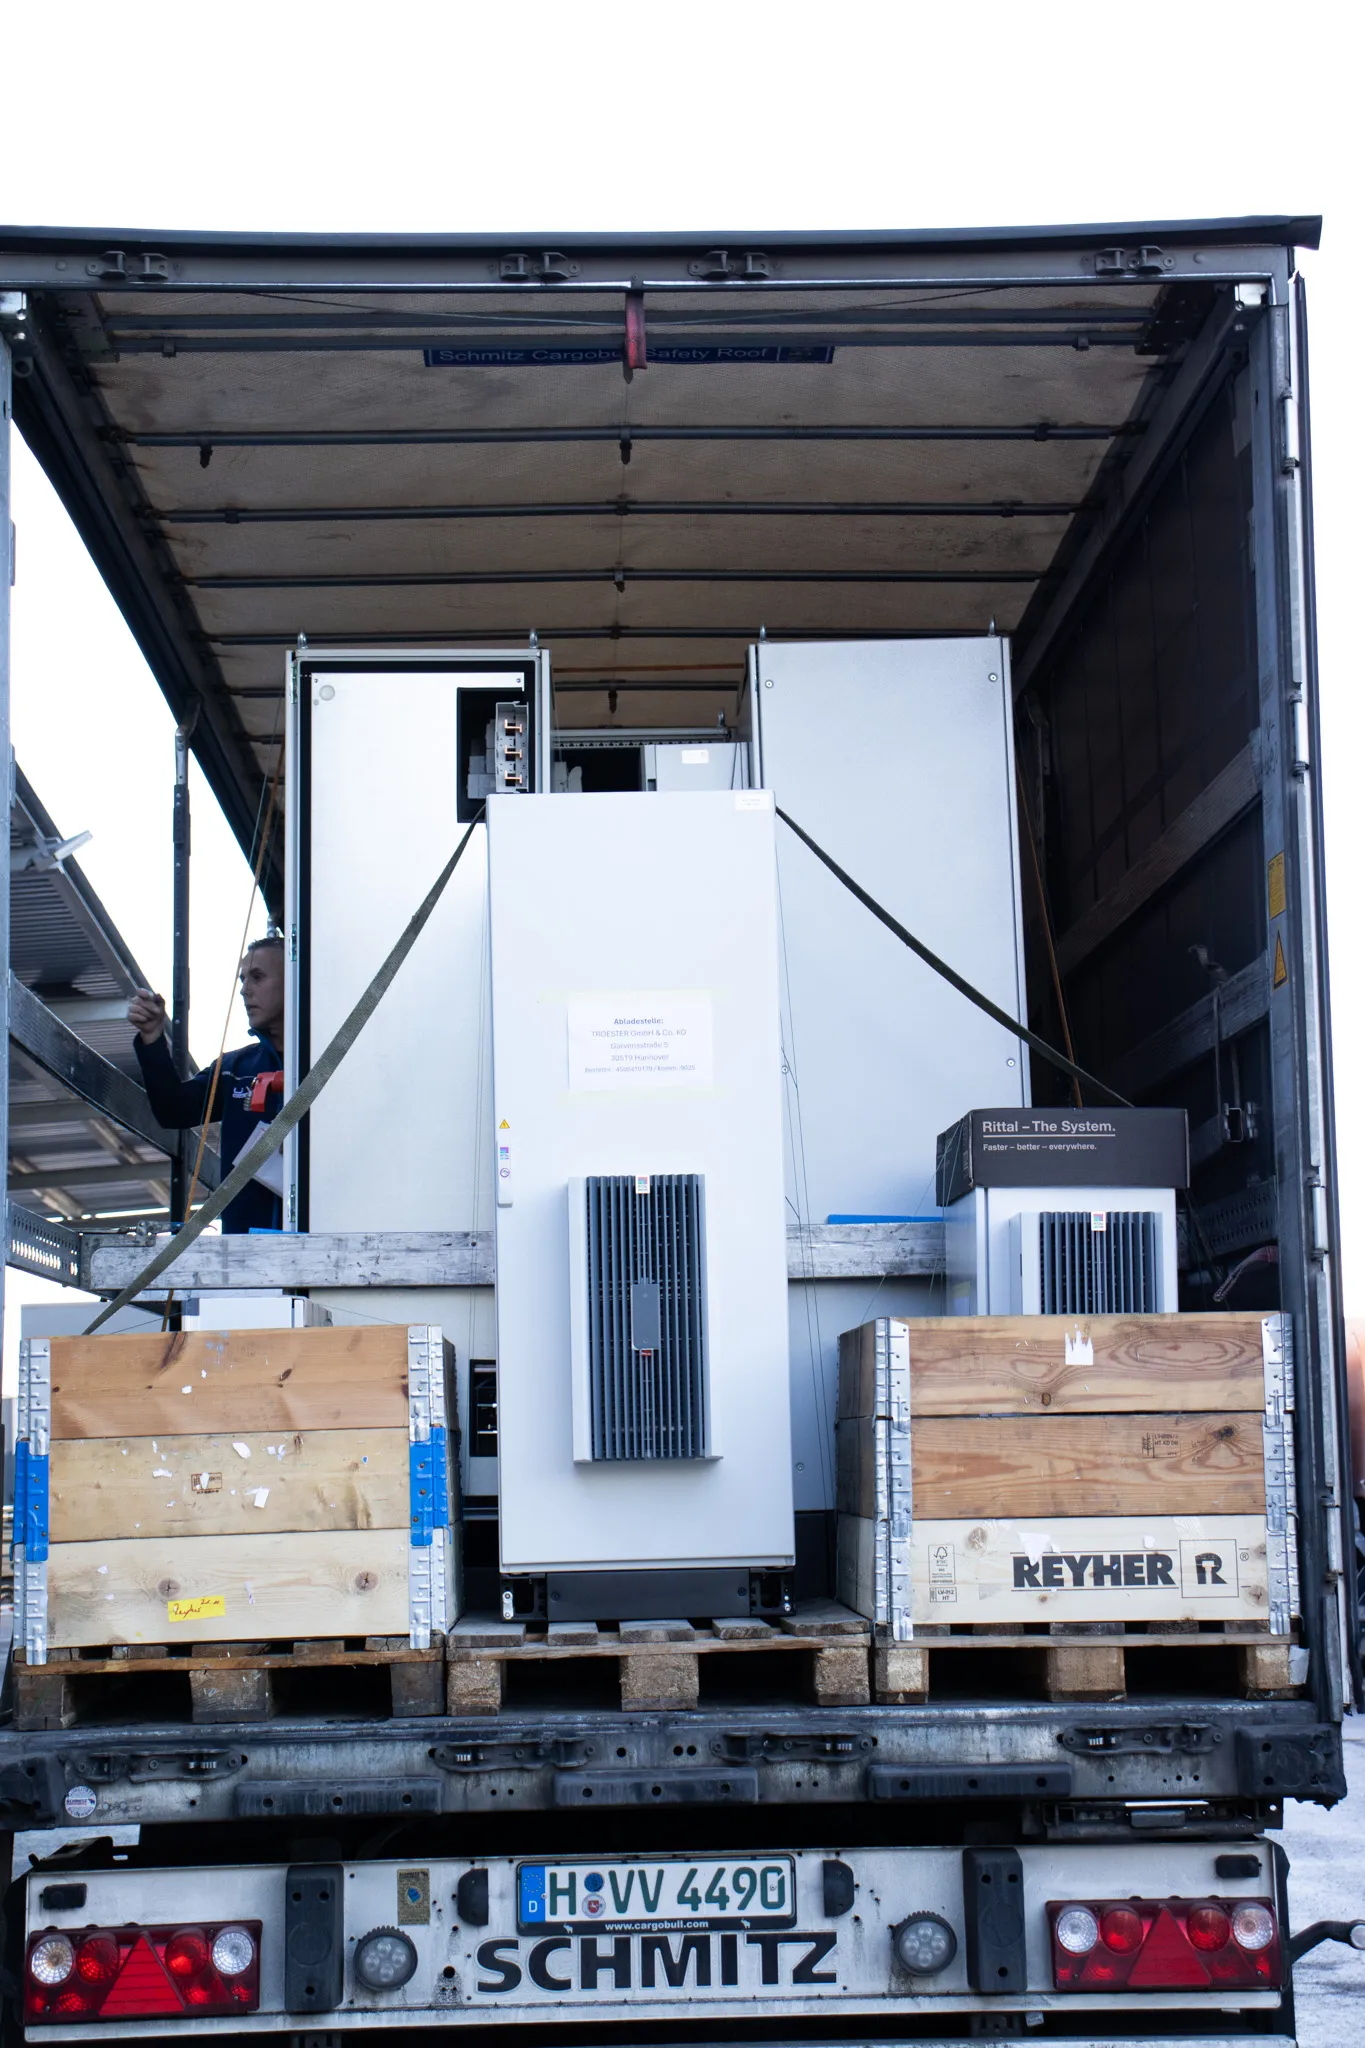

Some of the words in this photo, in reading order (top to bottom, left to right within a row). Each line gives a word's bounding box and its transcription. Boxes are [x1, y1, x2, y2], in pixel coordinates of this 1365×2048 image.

[439, 349, 525, 362] Schmitz
[532, 348, 620, 362] Cargobu
[646, 348, 710, 361] Safety
[717, 347, 769, 358] Roof
[613, 1017, 664, 1026] Abladestelle:
[630, 1029, 654, 1037] GmbH
[662, 1028, 675, 1036] Co.
[676, 1028, 687, 1036] KG
[982, 1120, 1019, 1133] Rittal
[1032, 1120, 1058, 1132] The
[1061, 1120, 1116, 1134] System.
[983, 1143, 1008, 1151] Faster
[1016, 1143, 1040, 1151] better
[1048, 1142, 1097, 1152] everywhere.
[1012, 1553, 1177, 1588] REYHER
[549, 1871, 577, 1916] H
[608, 1869, 665, 1914] VV
[676, 1866, 786, 1912] 4490
[528, 1900, 538, 1913] D
[605, 1919, 709, 1931] www.cargobull.com
[476, 1931, 839, 1994] SCHMITZ
